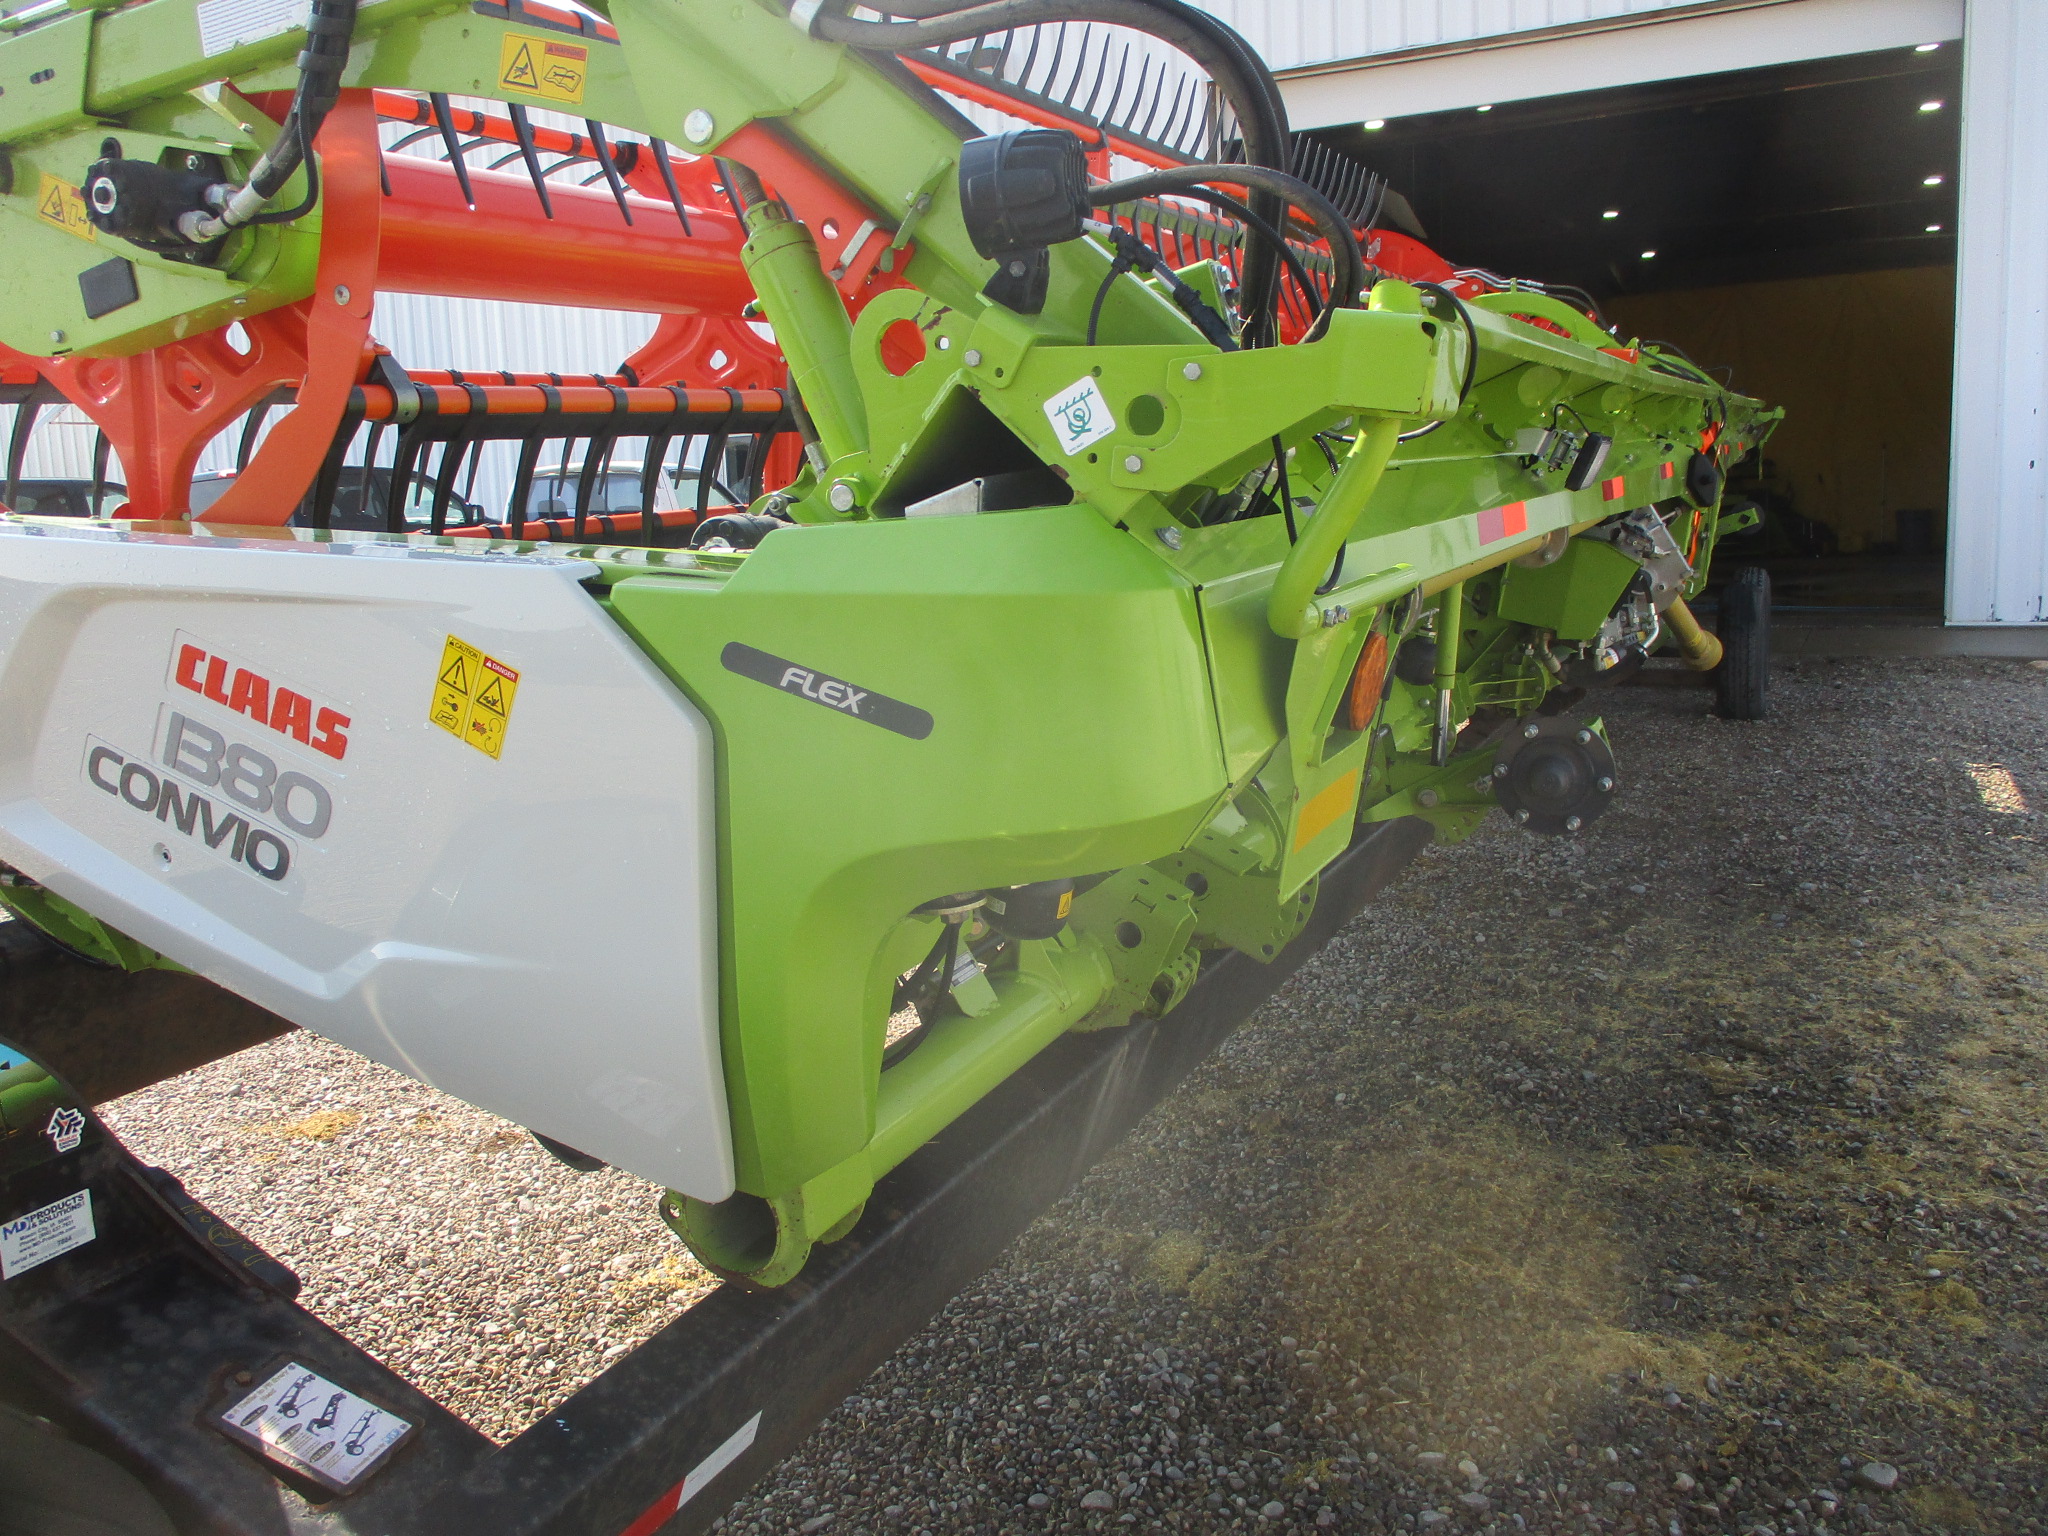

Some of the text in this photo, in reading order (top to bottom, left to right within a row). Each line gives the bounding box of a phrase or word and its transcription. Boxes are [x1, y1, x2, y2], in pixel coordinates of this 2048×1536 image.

[455, 642, 478, 659] CAUTION
[492, 663, 516, 680] DANGER
[175, 644, 351, 760] CLAAS
[779, 667, 867, 714] FLEX
[162, 711, 332, 839] B80
[88, 745, 290, 881] CONVIO
[30, 1193, 84, 1222] PRODUCTS
[39, 1203, 83, 1225] SOLUTIONS
[10, 1255, 27, 1267] Serial
